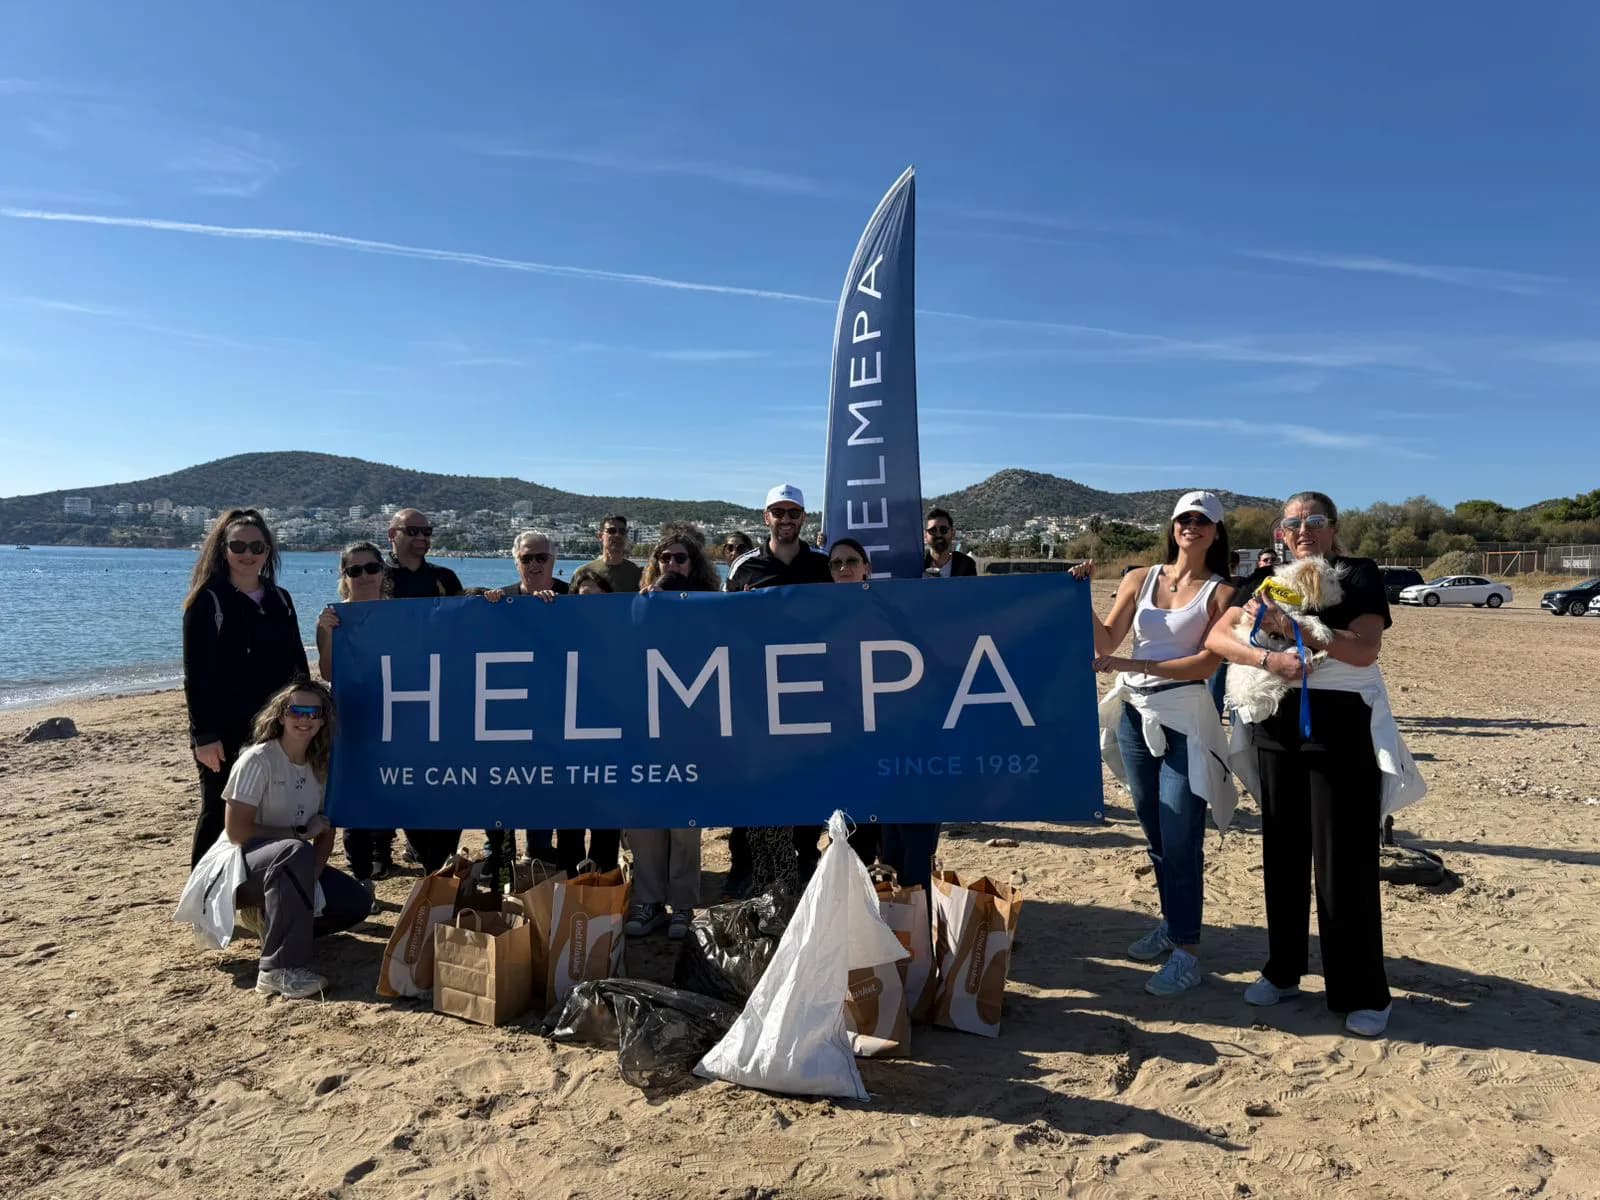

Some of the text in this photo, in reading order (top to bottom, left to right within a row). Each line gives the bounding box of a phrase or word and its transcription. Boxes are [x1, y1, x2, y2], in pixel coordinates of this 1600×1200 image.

[379, 634, 1036, 743] HELMEPA
[379, 763, 698, 785] WE CAN SAVE THE SEAS
[877, 753, 1041, 776] SINCE 1982
